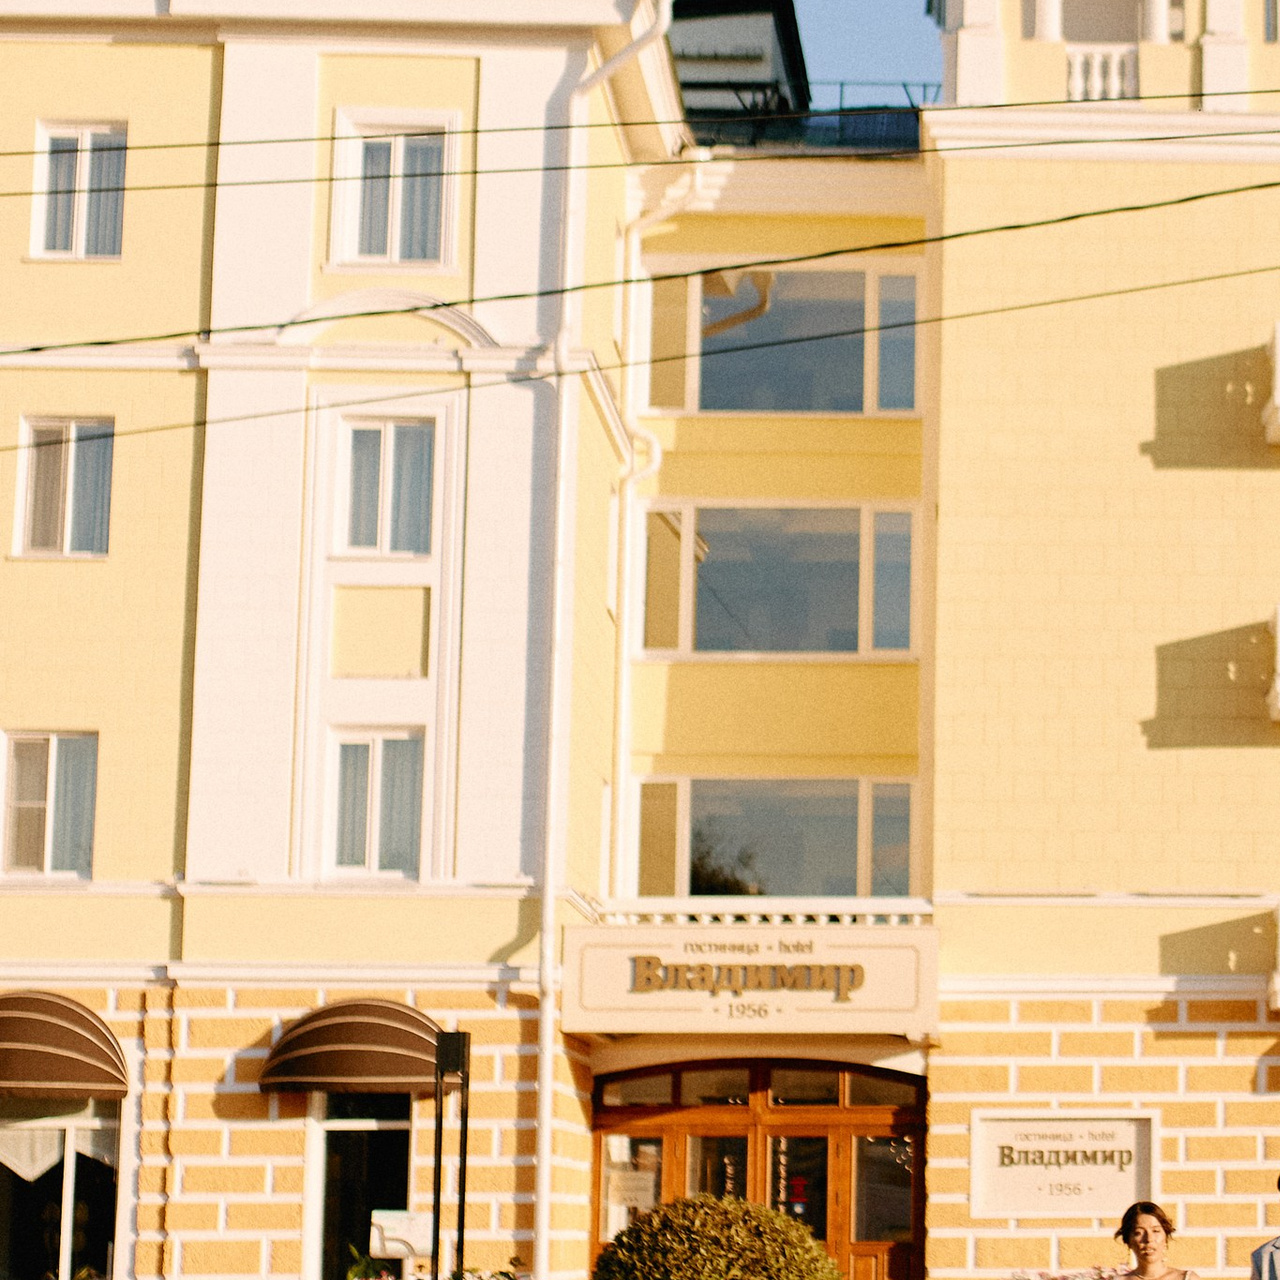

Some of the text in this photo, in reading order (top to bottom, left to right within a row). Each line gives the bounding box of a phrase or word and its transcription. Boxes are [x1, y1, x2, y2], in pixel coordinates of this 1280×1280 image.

[778, 940, 813, 954] hotel
[628, 956, 865, 1002] Владимир
[727, 1003, 768, 1018] 1956
[998, 1146, 1132, 1171] Владимир
[1049, 1183, 1082, 1196] 1956
